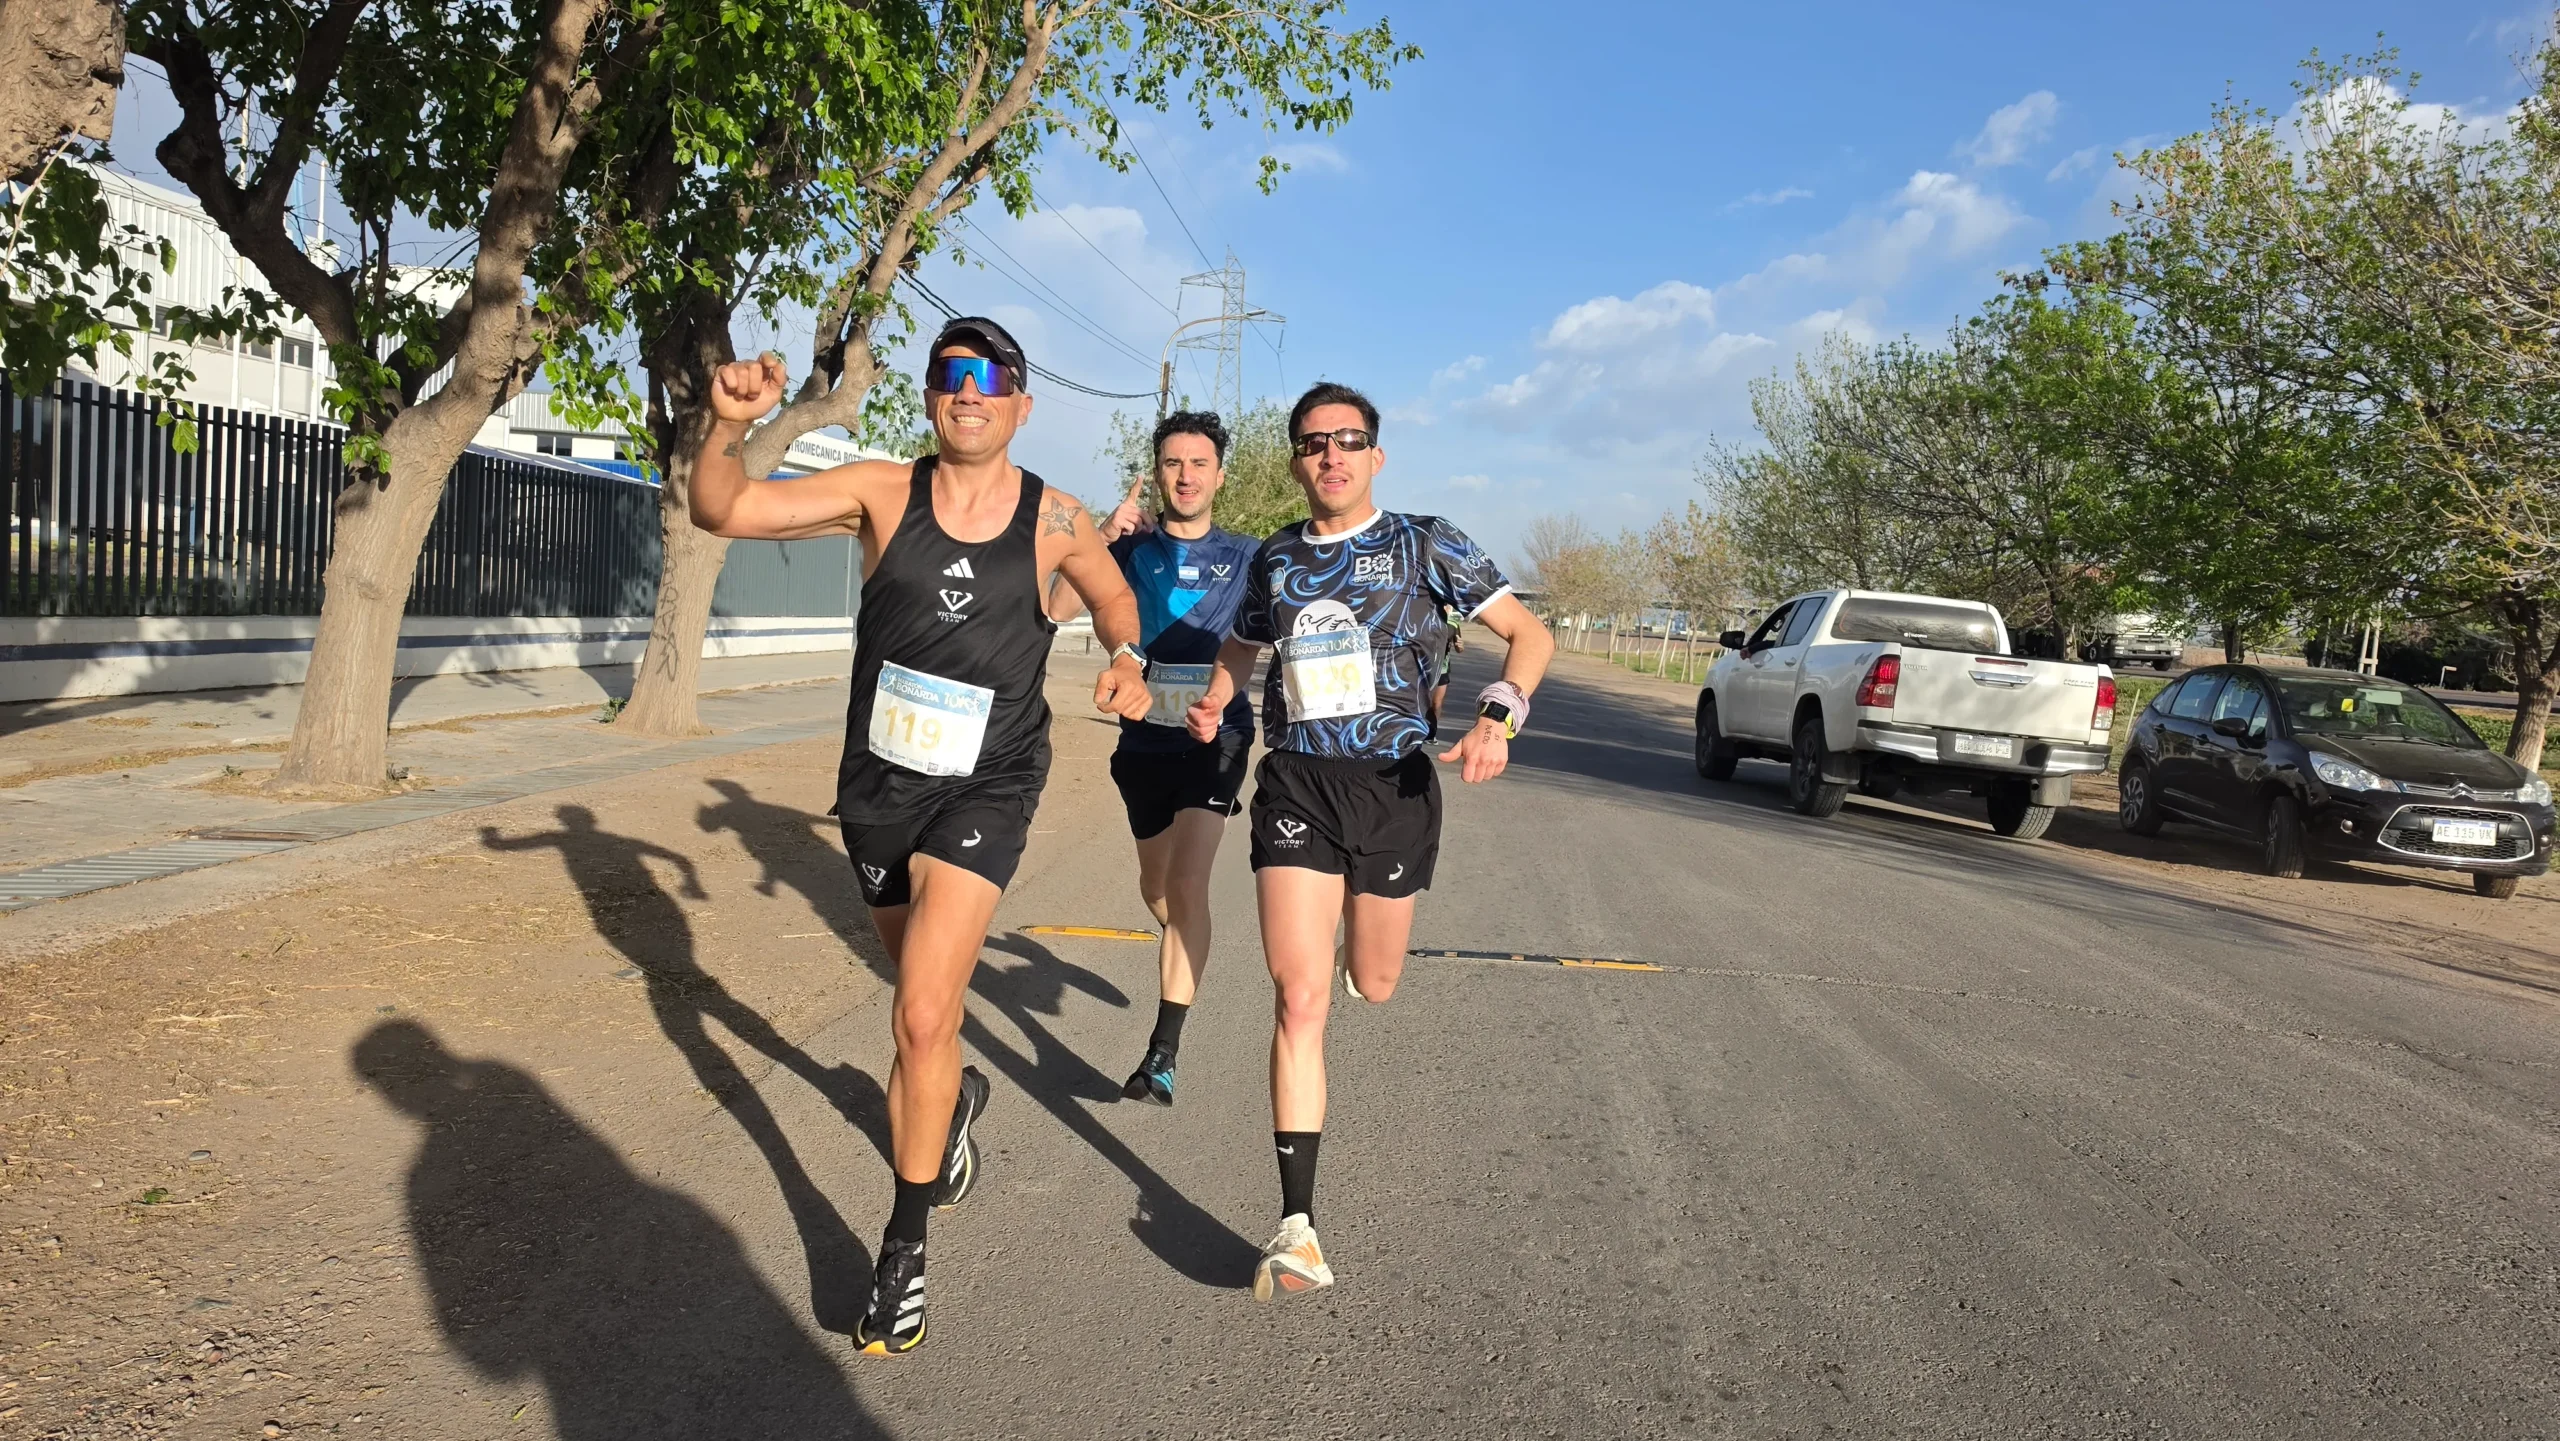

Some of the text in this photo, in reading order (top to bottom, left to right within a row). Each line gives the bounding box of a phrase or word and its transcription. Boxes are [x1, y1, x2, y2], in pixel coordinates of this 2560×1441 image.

[1353, 573, 1393, 583] BONARDA
[937, 611, 968, 621] VICTORY
[940, 616, 960, 624] TEAM
[1289, 637, 1352, 656] BONARDA 10K
[896, 684, 940, 703] BONARDA
[2436, 826, 2450, 837] AE
